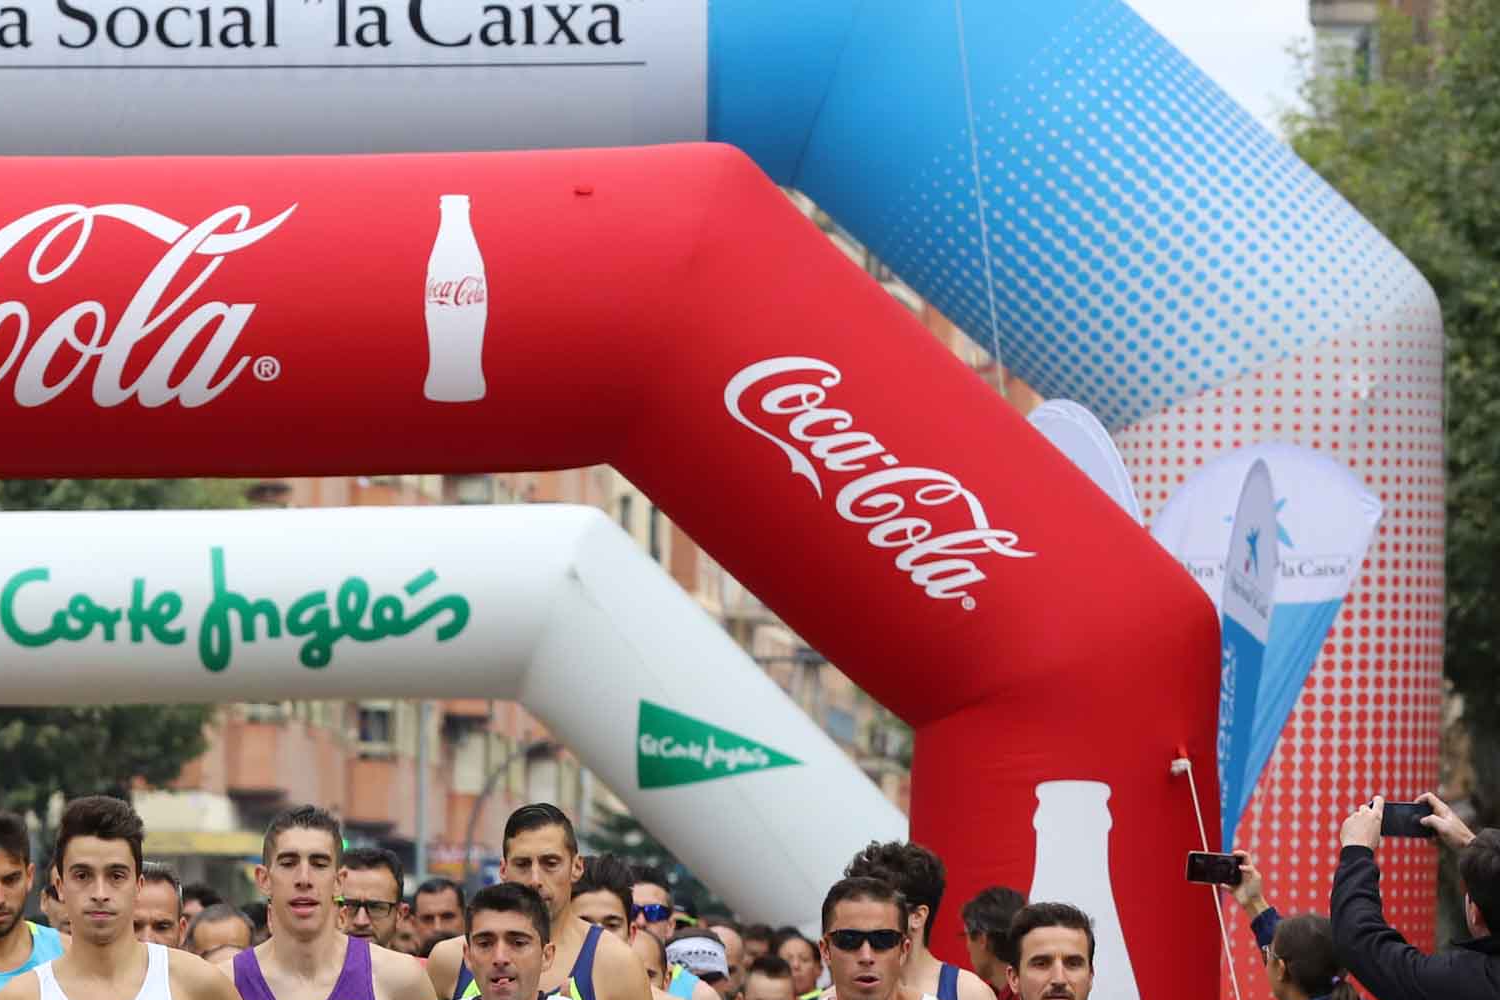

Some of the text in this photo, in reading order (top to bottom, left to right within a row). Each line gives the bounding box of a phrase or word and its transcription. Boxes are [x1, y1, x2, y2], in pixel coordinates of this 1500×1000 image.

[56, 0, 280, 49] Social
[724, 356, 1037, 600] Coca-Cola
[0, 567, 186, 648] Corte
[199, 546, 471, 673] Inglés
